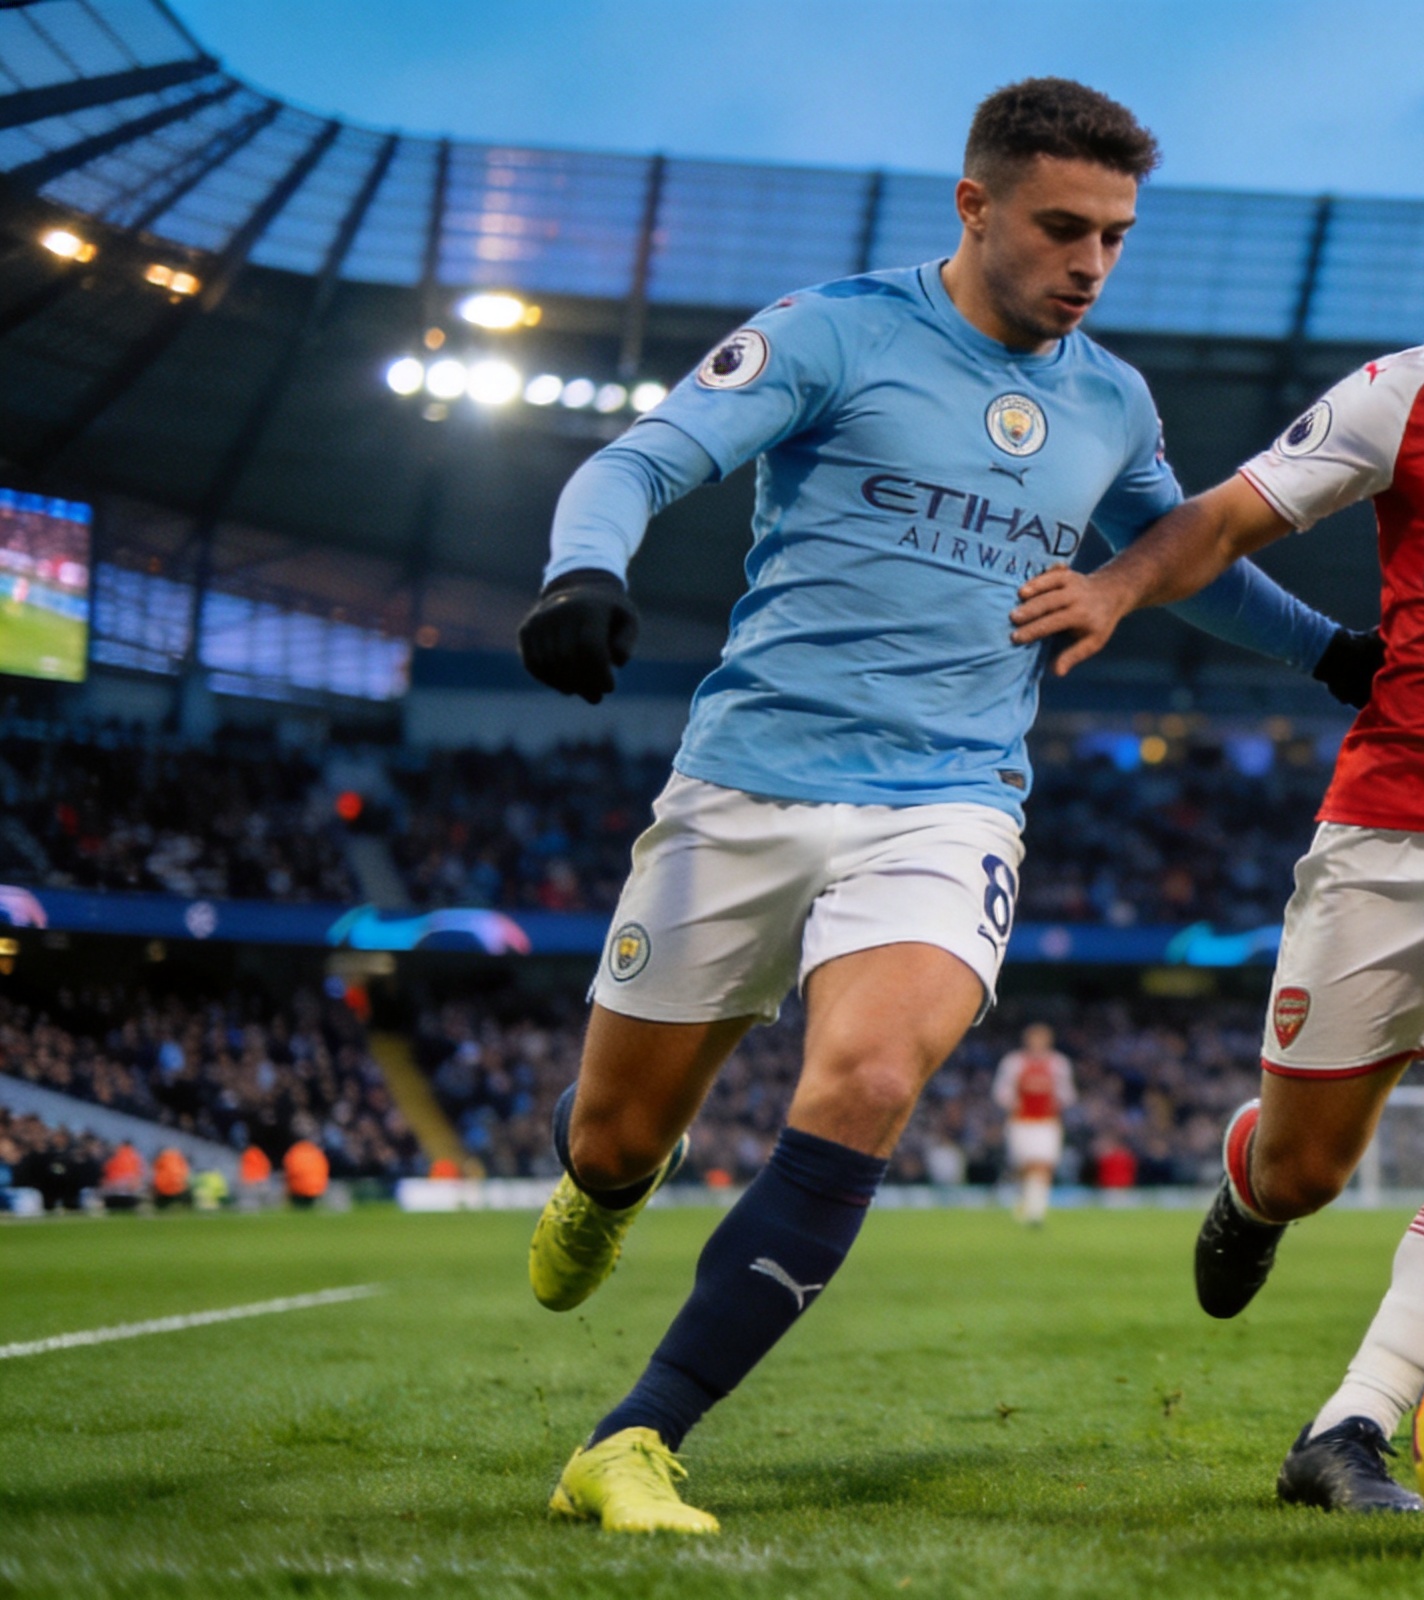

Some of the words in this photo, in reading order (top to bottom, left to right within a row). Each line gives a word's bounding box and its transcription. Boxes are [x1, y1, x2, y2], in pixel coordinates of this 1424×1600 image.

[861, 473, 1081, 557] ETIHAD
[898, 525, 1048, 582] AIRWA
[981, 853, 1016, 938] 8
